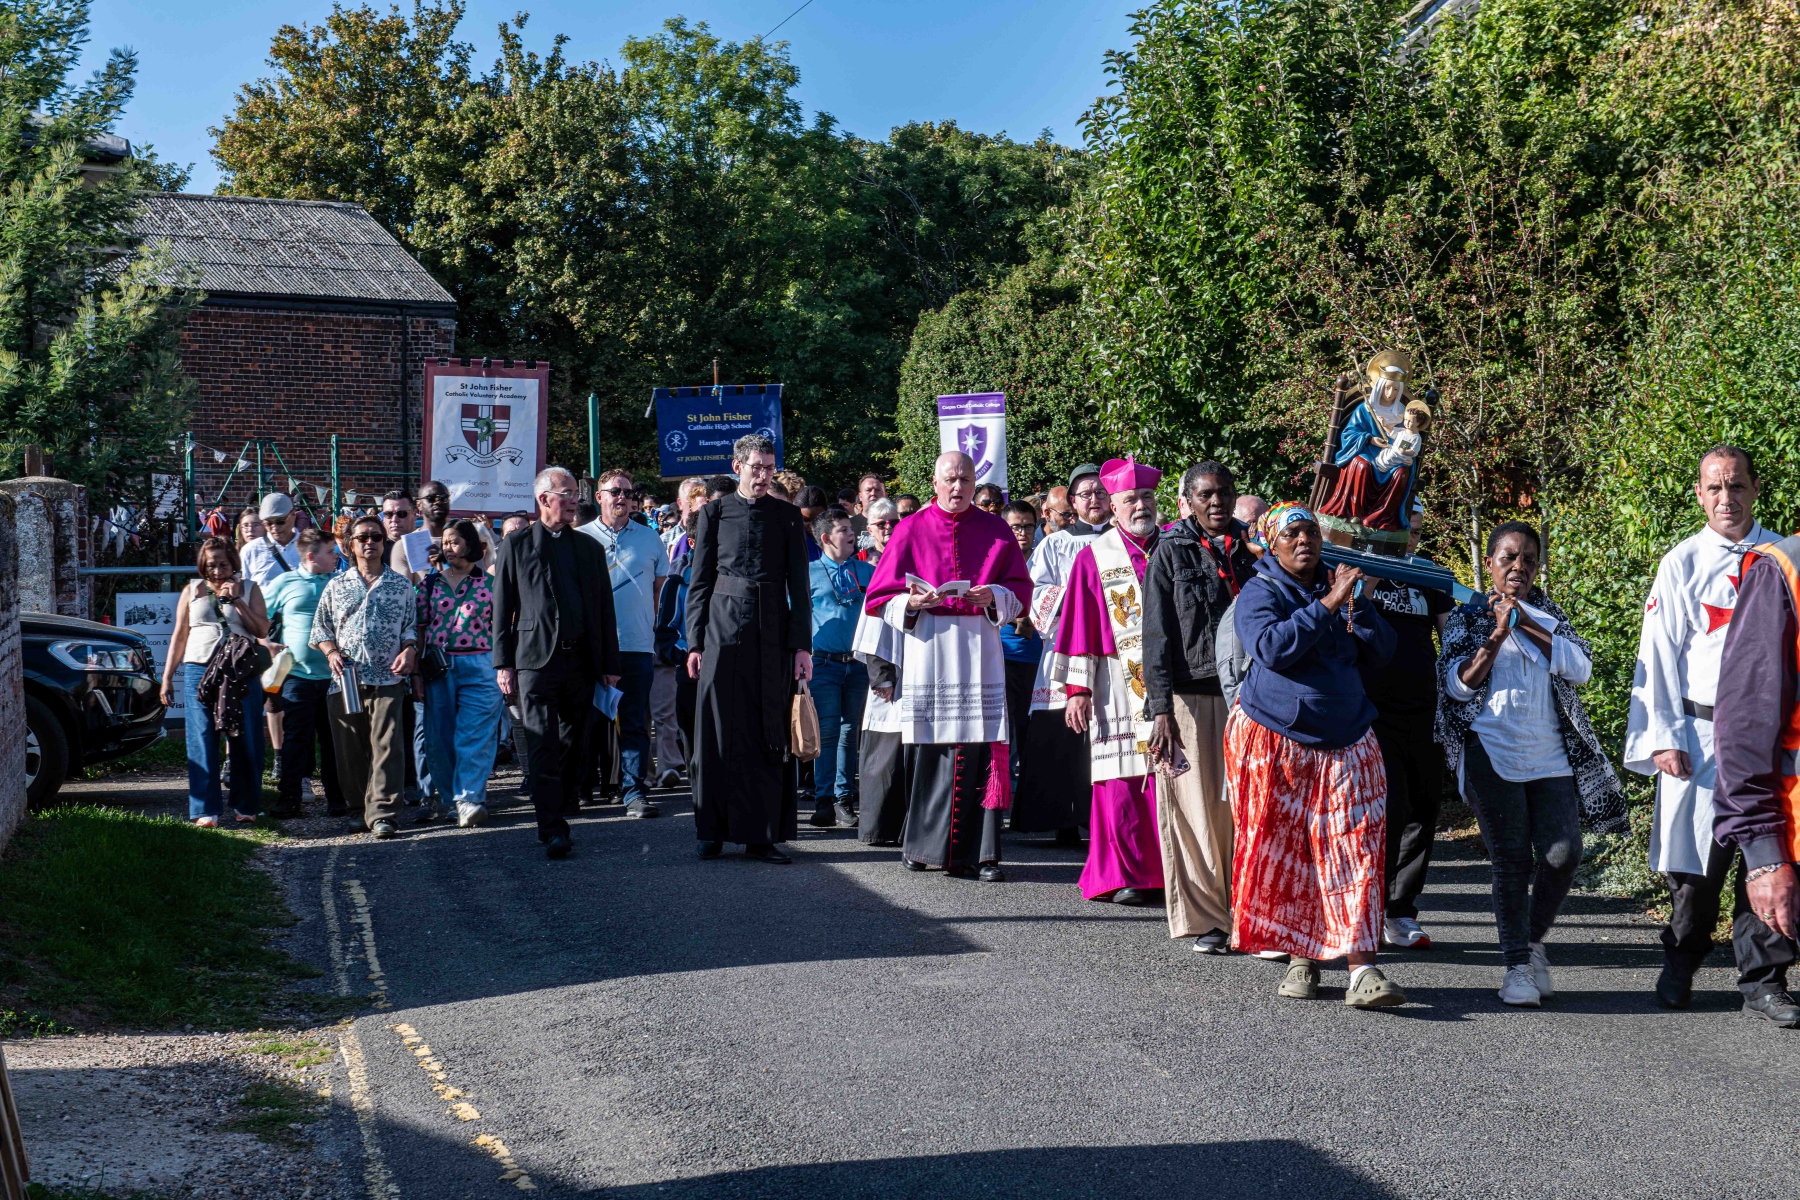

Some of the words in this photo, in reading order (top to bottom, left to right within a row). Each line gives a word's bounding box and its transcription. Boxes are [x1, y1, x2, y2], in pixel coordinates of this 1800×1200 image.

[687, 414, 697, 422] St
[699, 414, 721, 424] John
[723, 413, 752, 421] Fisher
[1373, 589, 1404, 602] NOR
[1383, 600, 1411, 613] FACE
